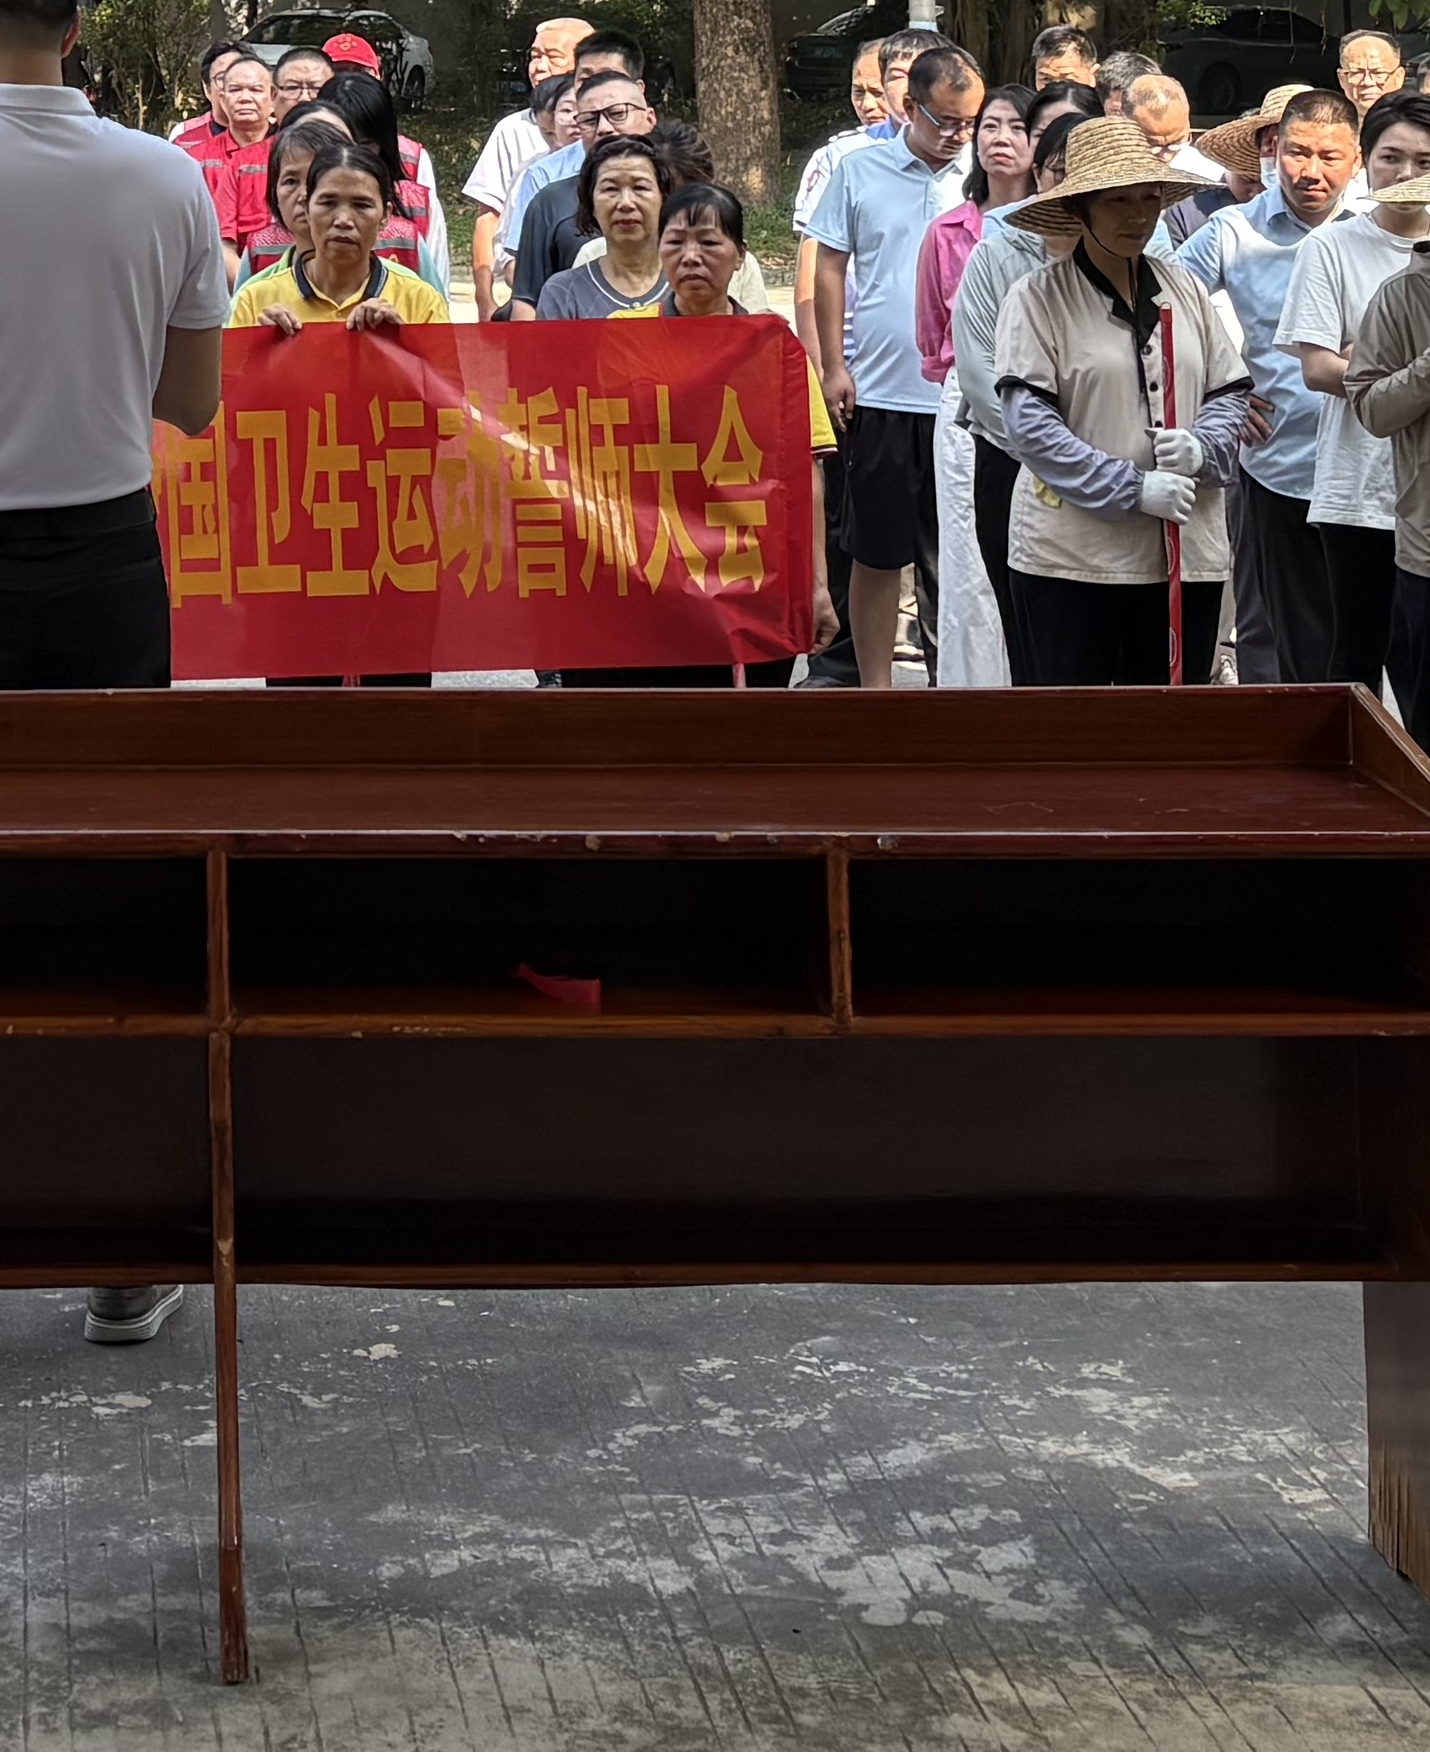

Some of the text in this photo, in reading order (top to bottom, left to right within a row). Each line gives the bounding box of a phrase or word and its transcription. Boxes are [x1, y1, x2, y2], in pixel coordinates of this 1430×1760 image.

[152, 385, 767, 607] 国卫生运动誓师大会
